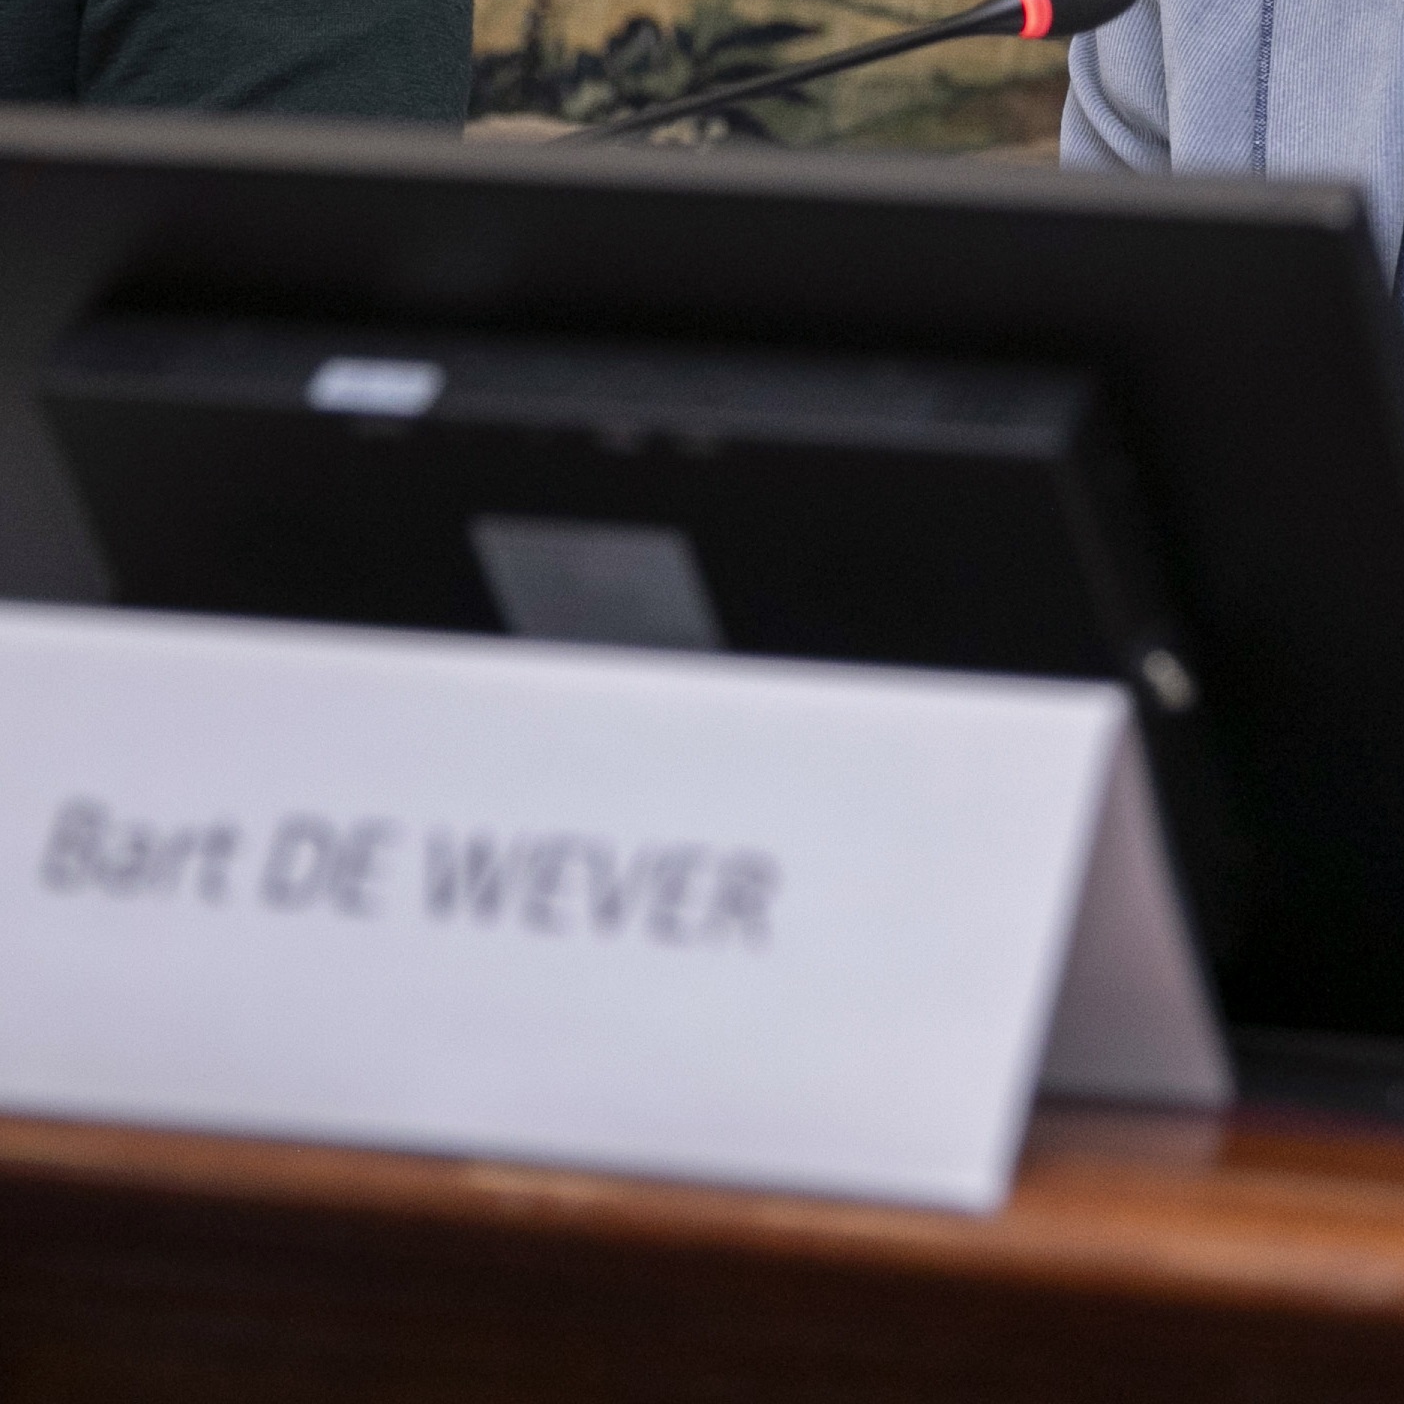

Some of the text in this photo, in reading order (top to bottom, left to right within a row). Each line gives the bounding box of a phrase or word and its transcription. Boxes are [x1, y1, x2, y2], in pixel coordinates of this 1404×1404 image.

[42, 797, 780, 946] Bart DE WEVER
